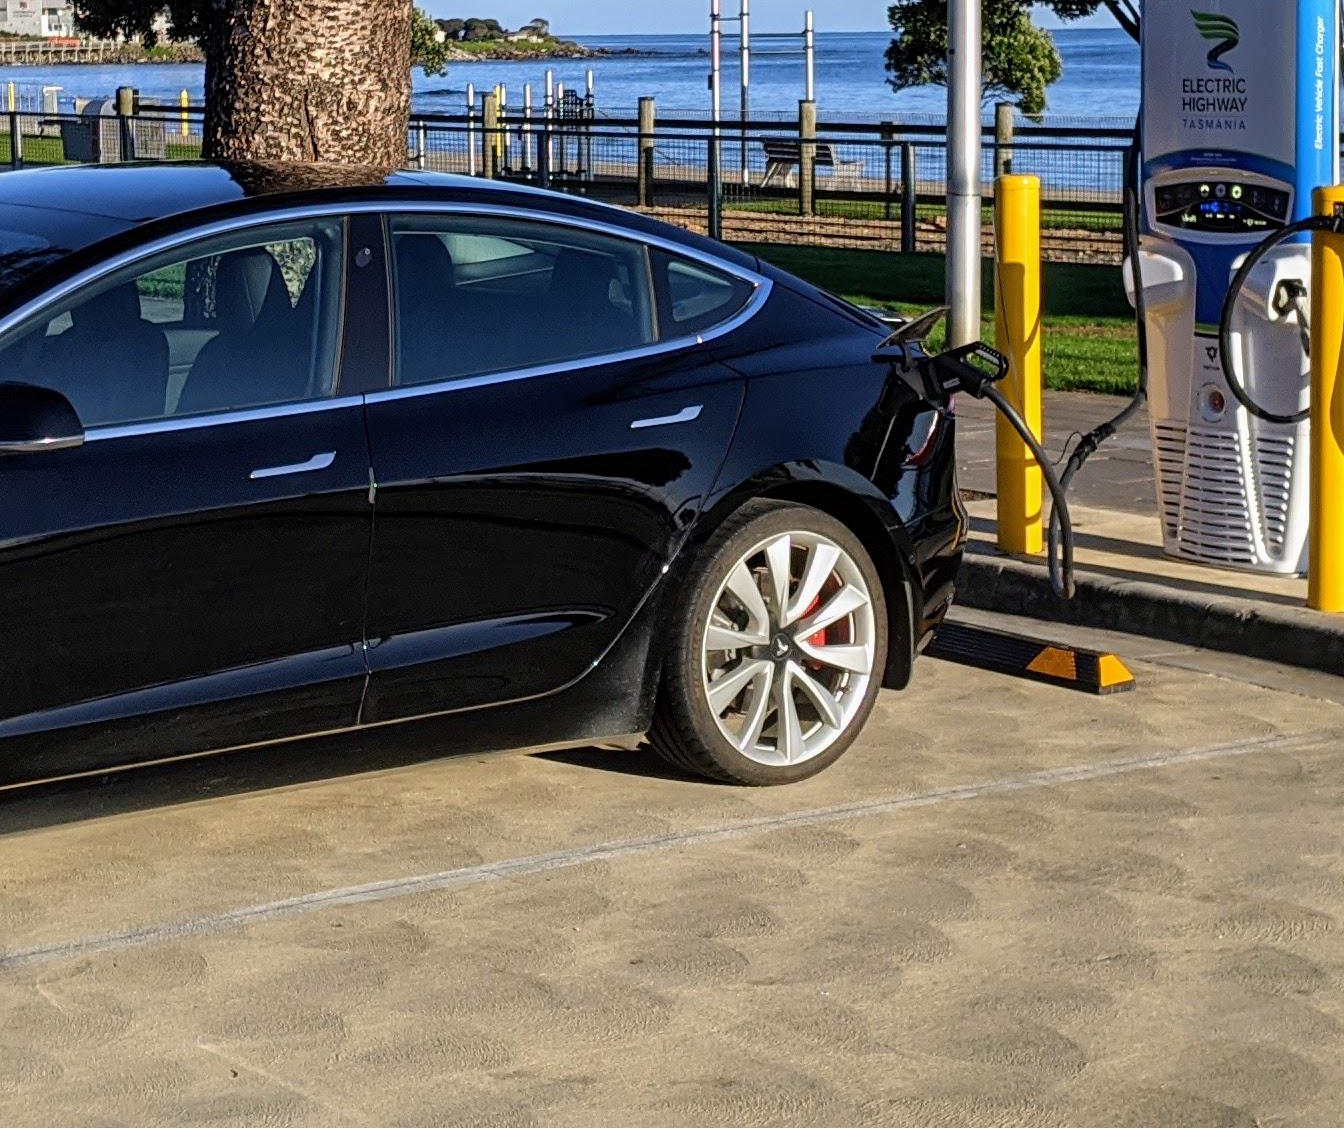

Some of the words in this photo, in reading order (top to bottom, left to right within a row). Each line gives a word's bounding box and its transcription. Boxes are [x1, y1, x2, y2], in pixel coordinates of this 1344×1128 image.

[1316, 16, 1325, 55] Charger
[1315, 56, 1324, 78] Fast
[1182, 78, 1246, 94] ELECTRIC
[1315, 79, 1324, 112] Vehicle
[1182, 97, 1248, 113] HIGHWAY
[1183, 118, 1247, 130] TASMANIA
[1314, 114, 1324, 150] Electric
